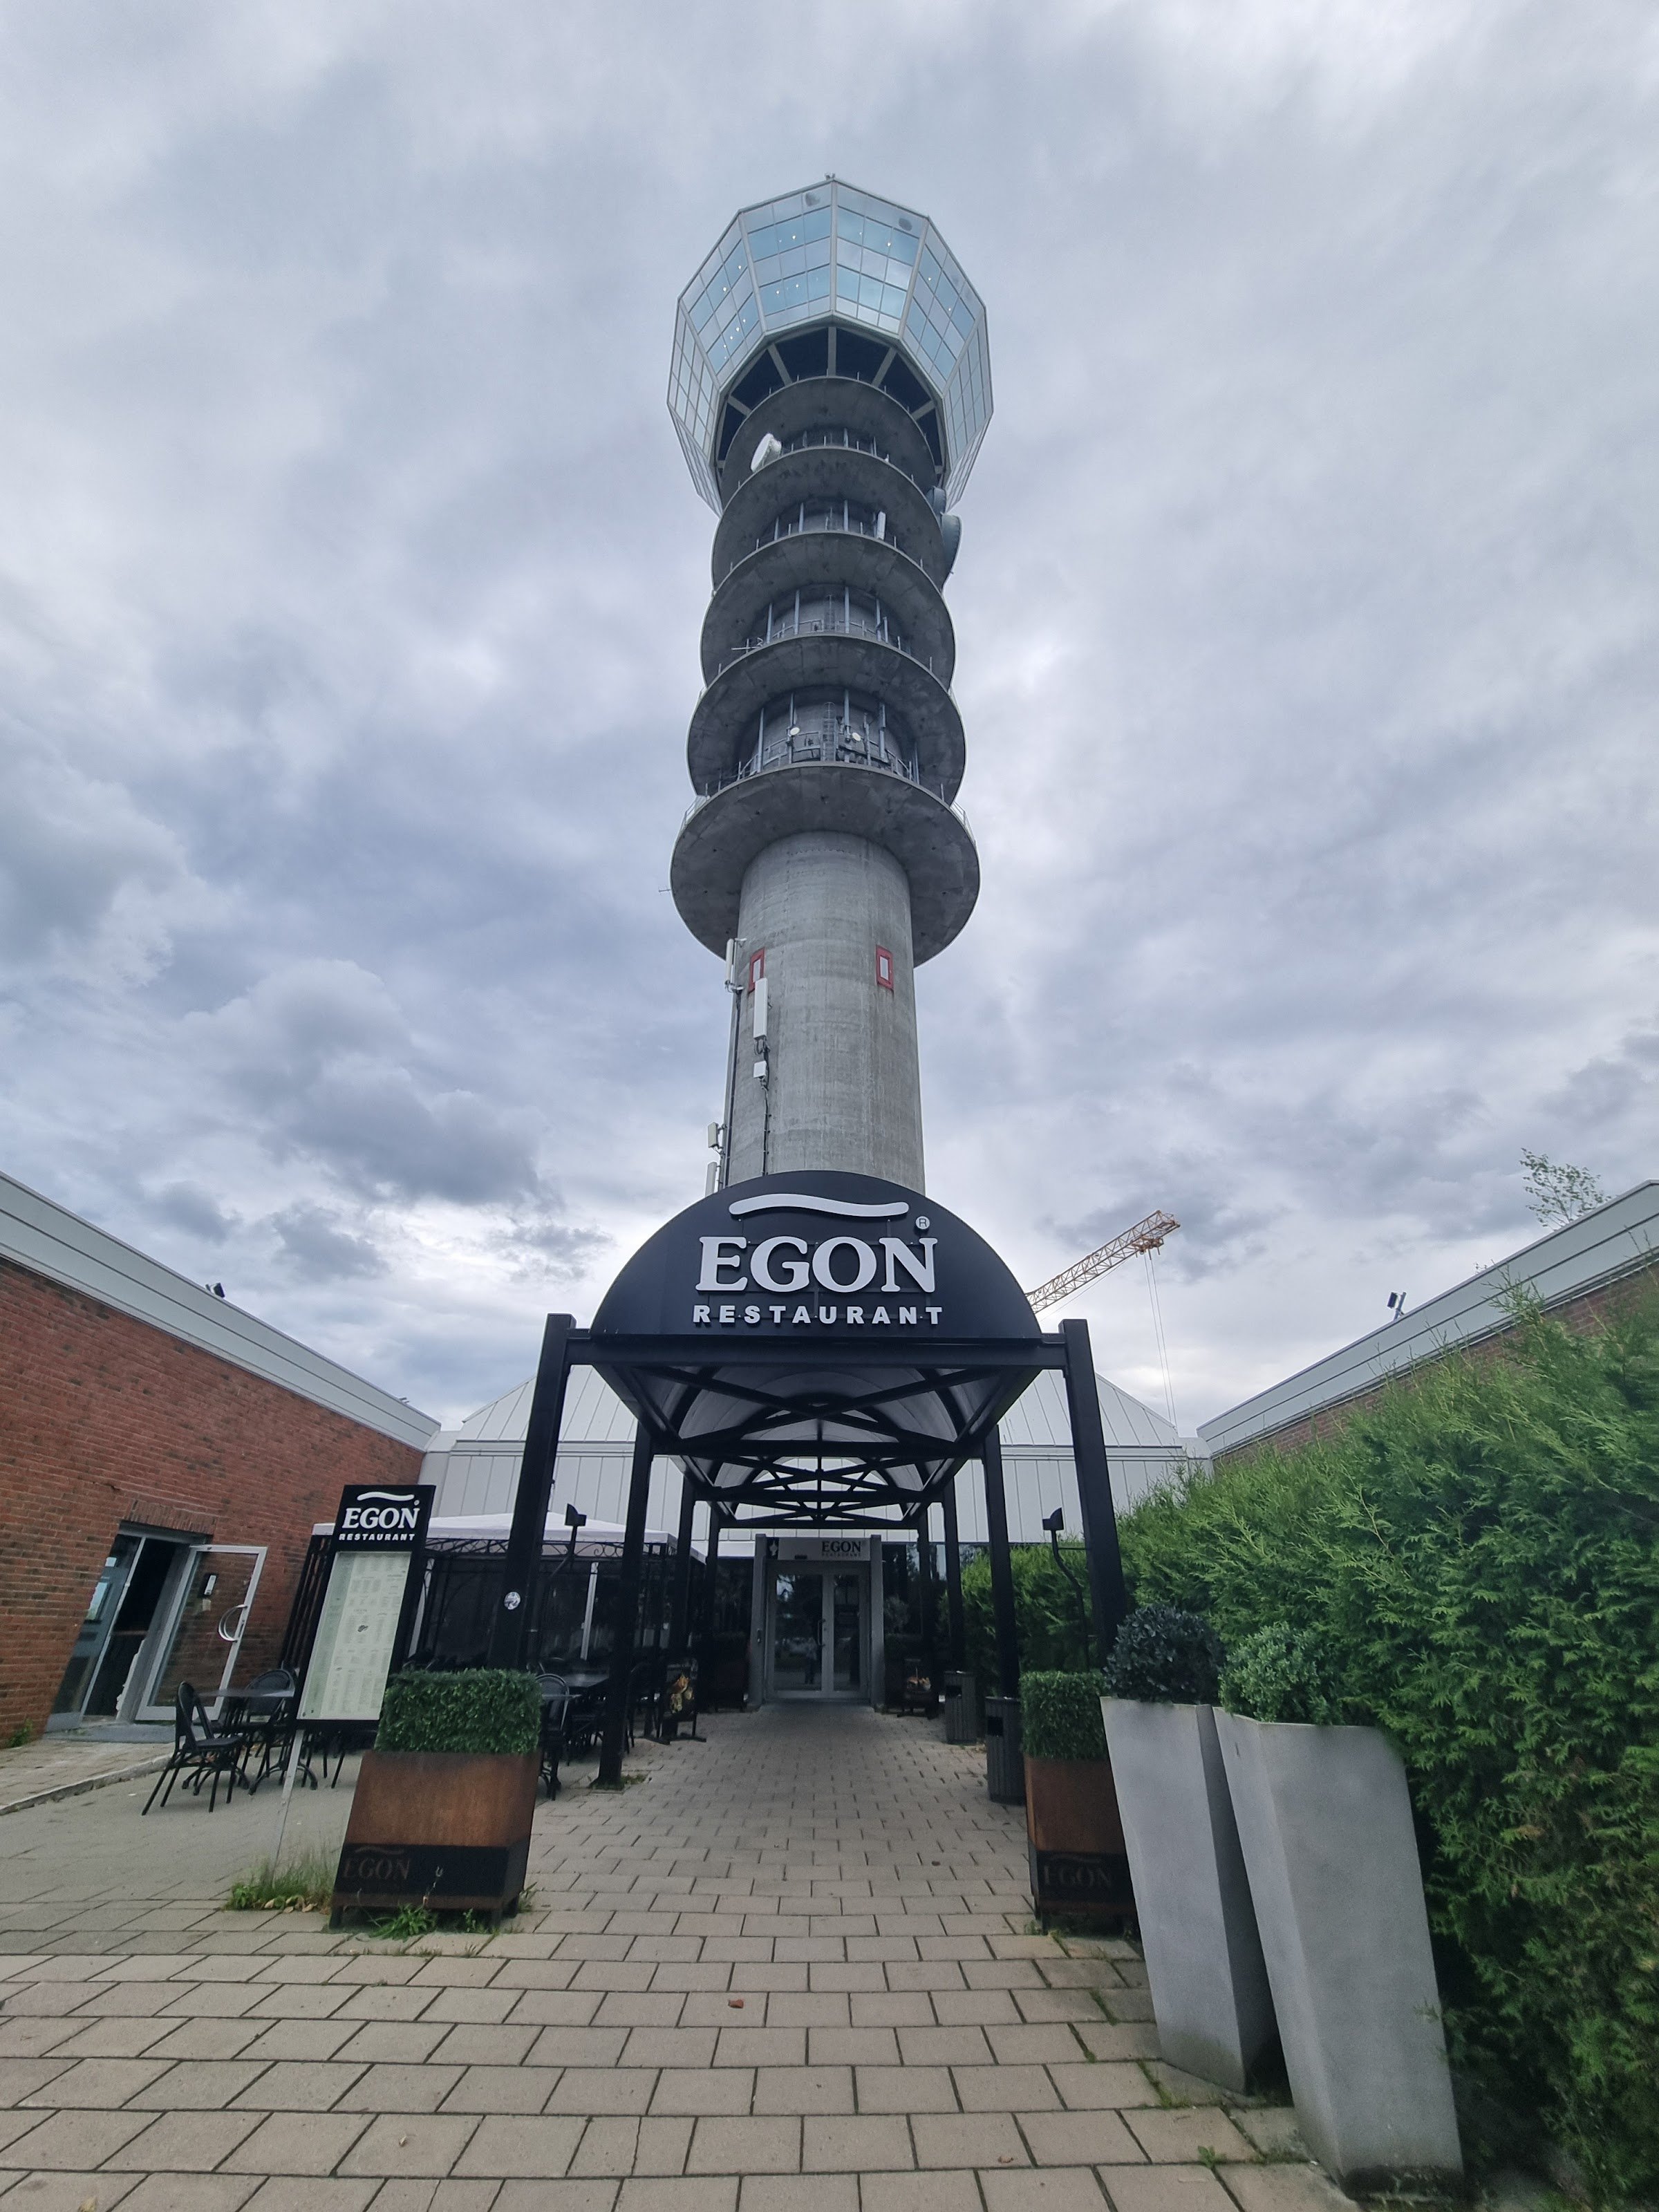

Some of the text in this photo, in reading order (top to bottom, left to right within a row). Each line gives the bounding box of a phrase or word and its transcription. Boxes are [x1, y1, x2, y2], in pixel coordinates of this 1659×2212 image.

[695, 1236, 938, 1293] EGON
[693, 1304, 943, 1324] RESTAURANT
[342, 1508, 420, 1529] EGON
[339, 1533, 415, 1541] RESTAURANT
[822, 1541, 861, 1553] EGON
